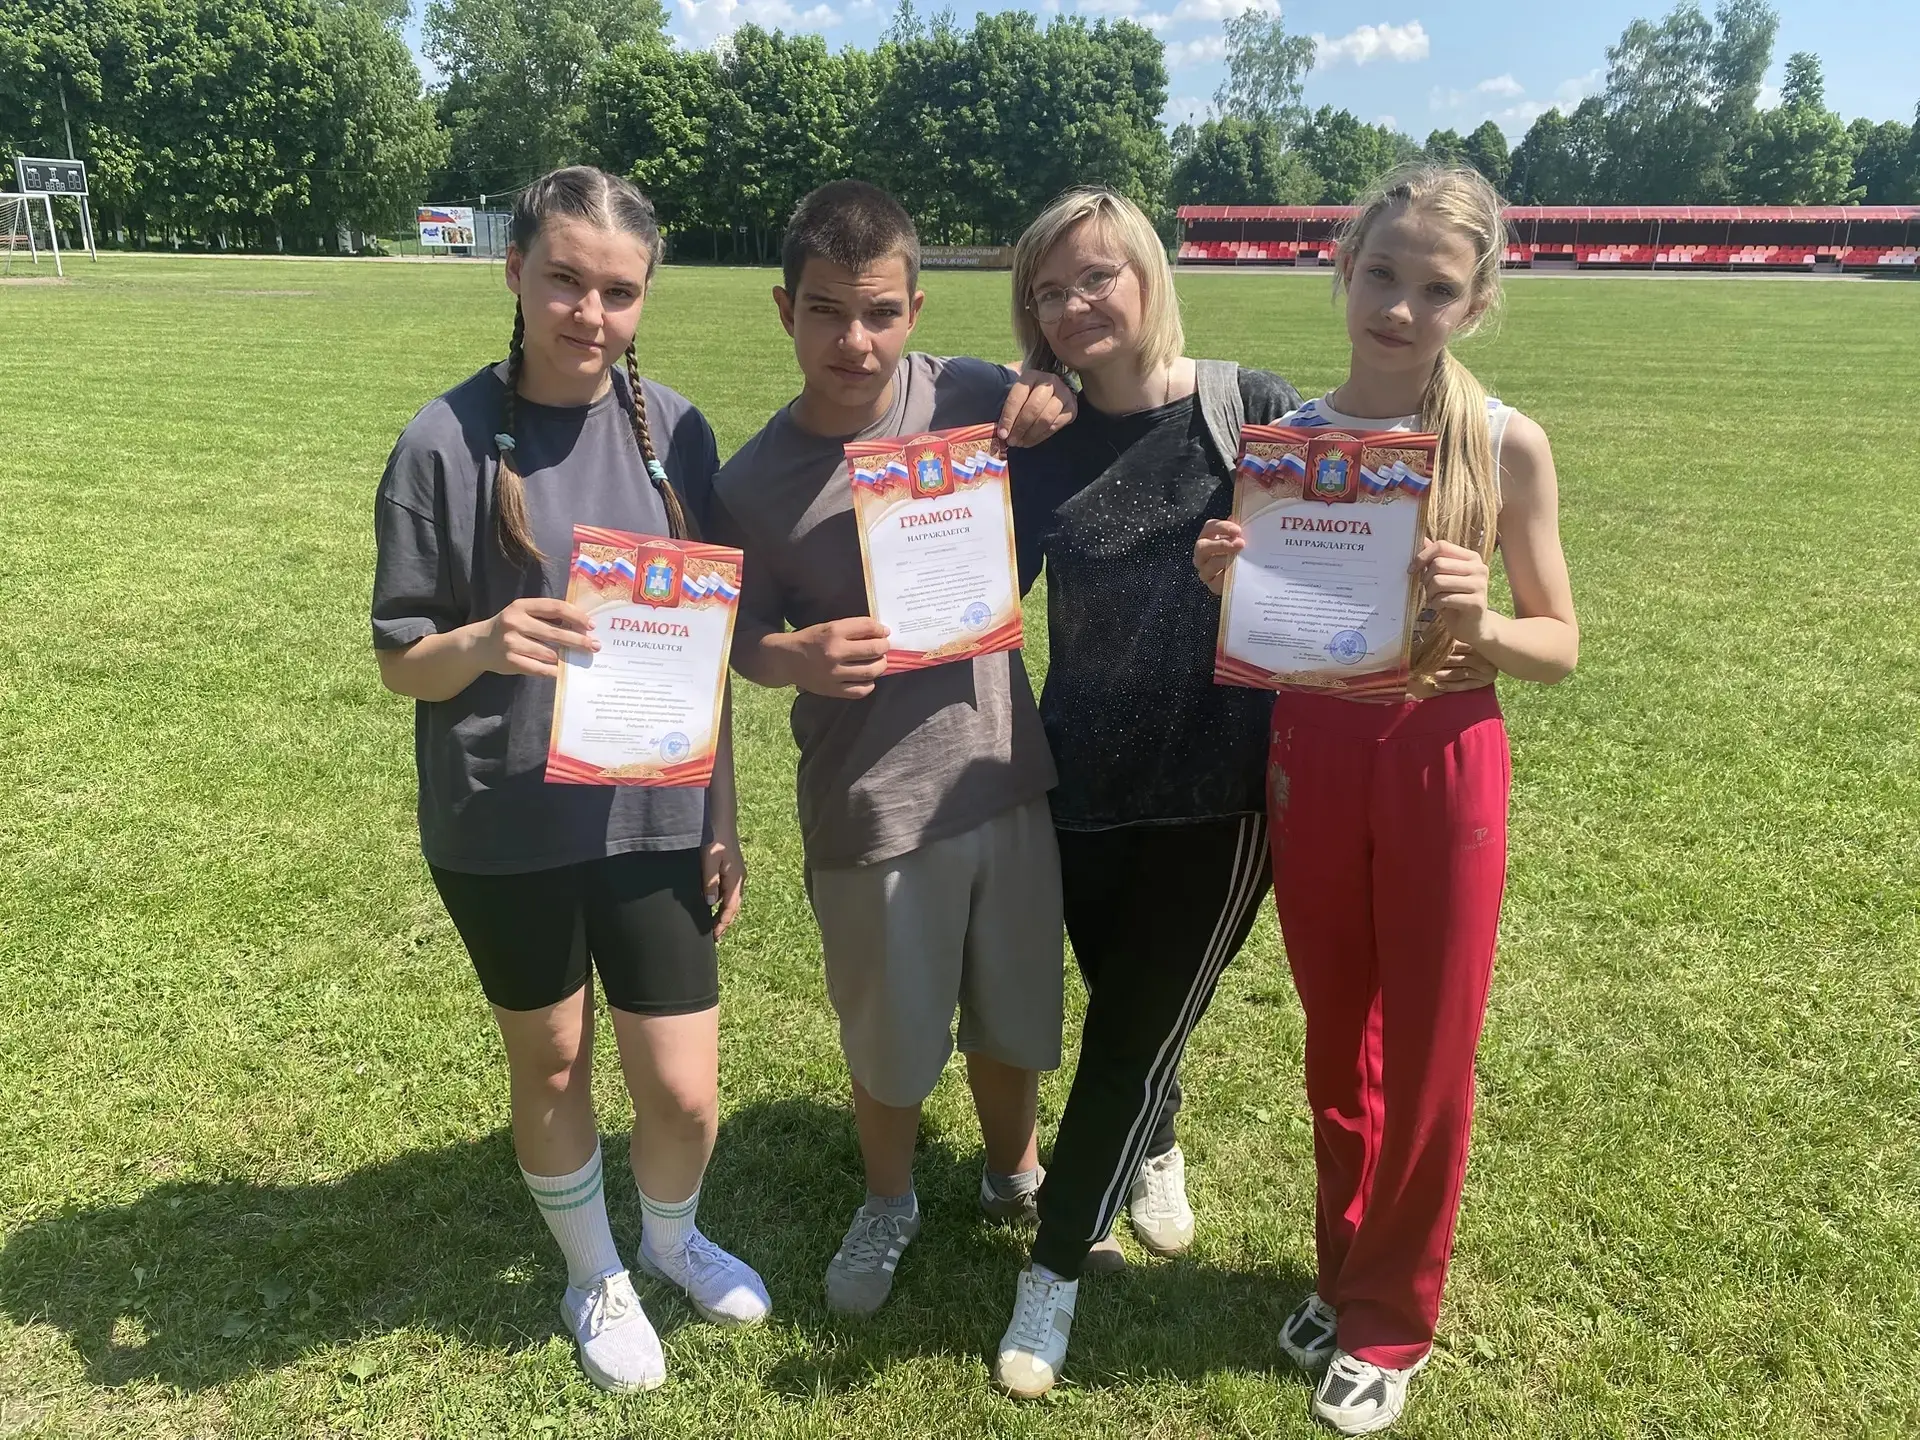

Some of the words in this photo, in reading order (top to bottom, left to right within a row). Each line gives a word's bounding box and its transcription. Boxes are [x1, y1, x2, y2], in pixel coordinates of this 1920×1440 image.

[920, 248, 943, 256] ОВЦЫ
[945, 248, 955, 256] ЗА
[957, 247, 1001, 257] ЗДОРОВЫЙ
[922, 257, 947, 265] ОБРАЗ
[949, 257, 979, 265] ЖИЗНИ!
[900, 507, 973, 529] ГРАМОТА
[1280, 516, 1373, 535] ГРАМОТА
[907, 526, 970, 543] НАГРАЖДАЕТСЯ
[1285, 538, 1365, 551] НАГРАЖДАЕТСЯ
[609, 617, 690, 638] ГРАМОТА
[612, 639, 683, 652] НАГРАЖДАЕТСЯ
